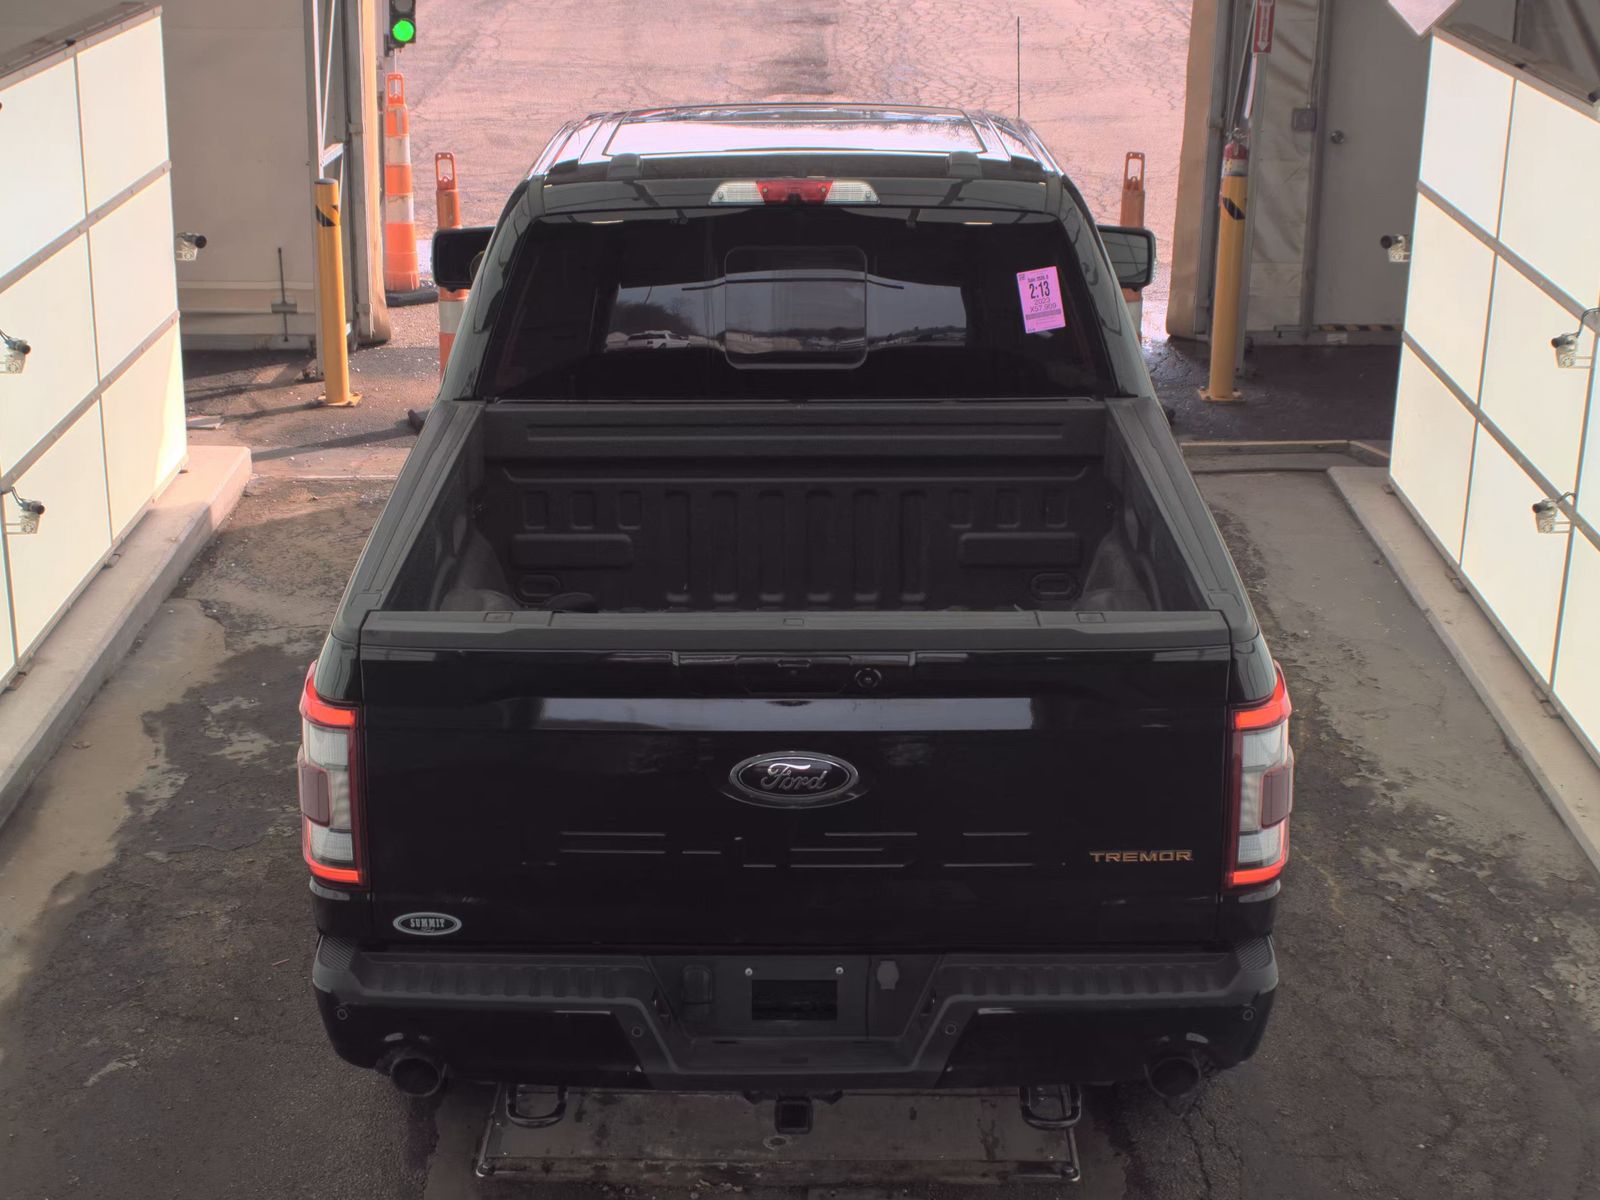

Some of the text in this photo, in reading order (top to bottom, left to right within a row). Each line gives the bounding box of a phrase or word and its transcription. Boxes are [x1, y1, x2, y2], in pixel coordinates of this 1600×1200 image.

[1029, 281, 1050, 299] 2:13
[761, 763, 828, 790] Ford
[1089, 850, 1193, 862] TREMOR
[410, 918, 445, 928] SUMMIT
